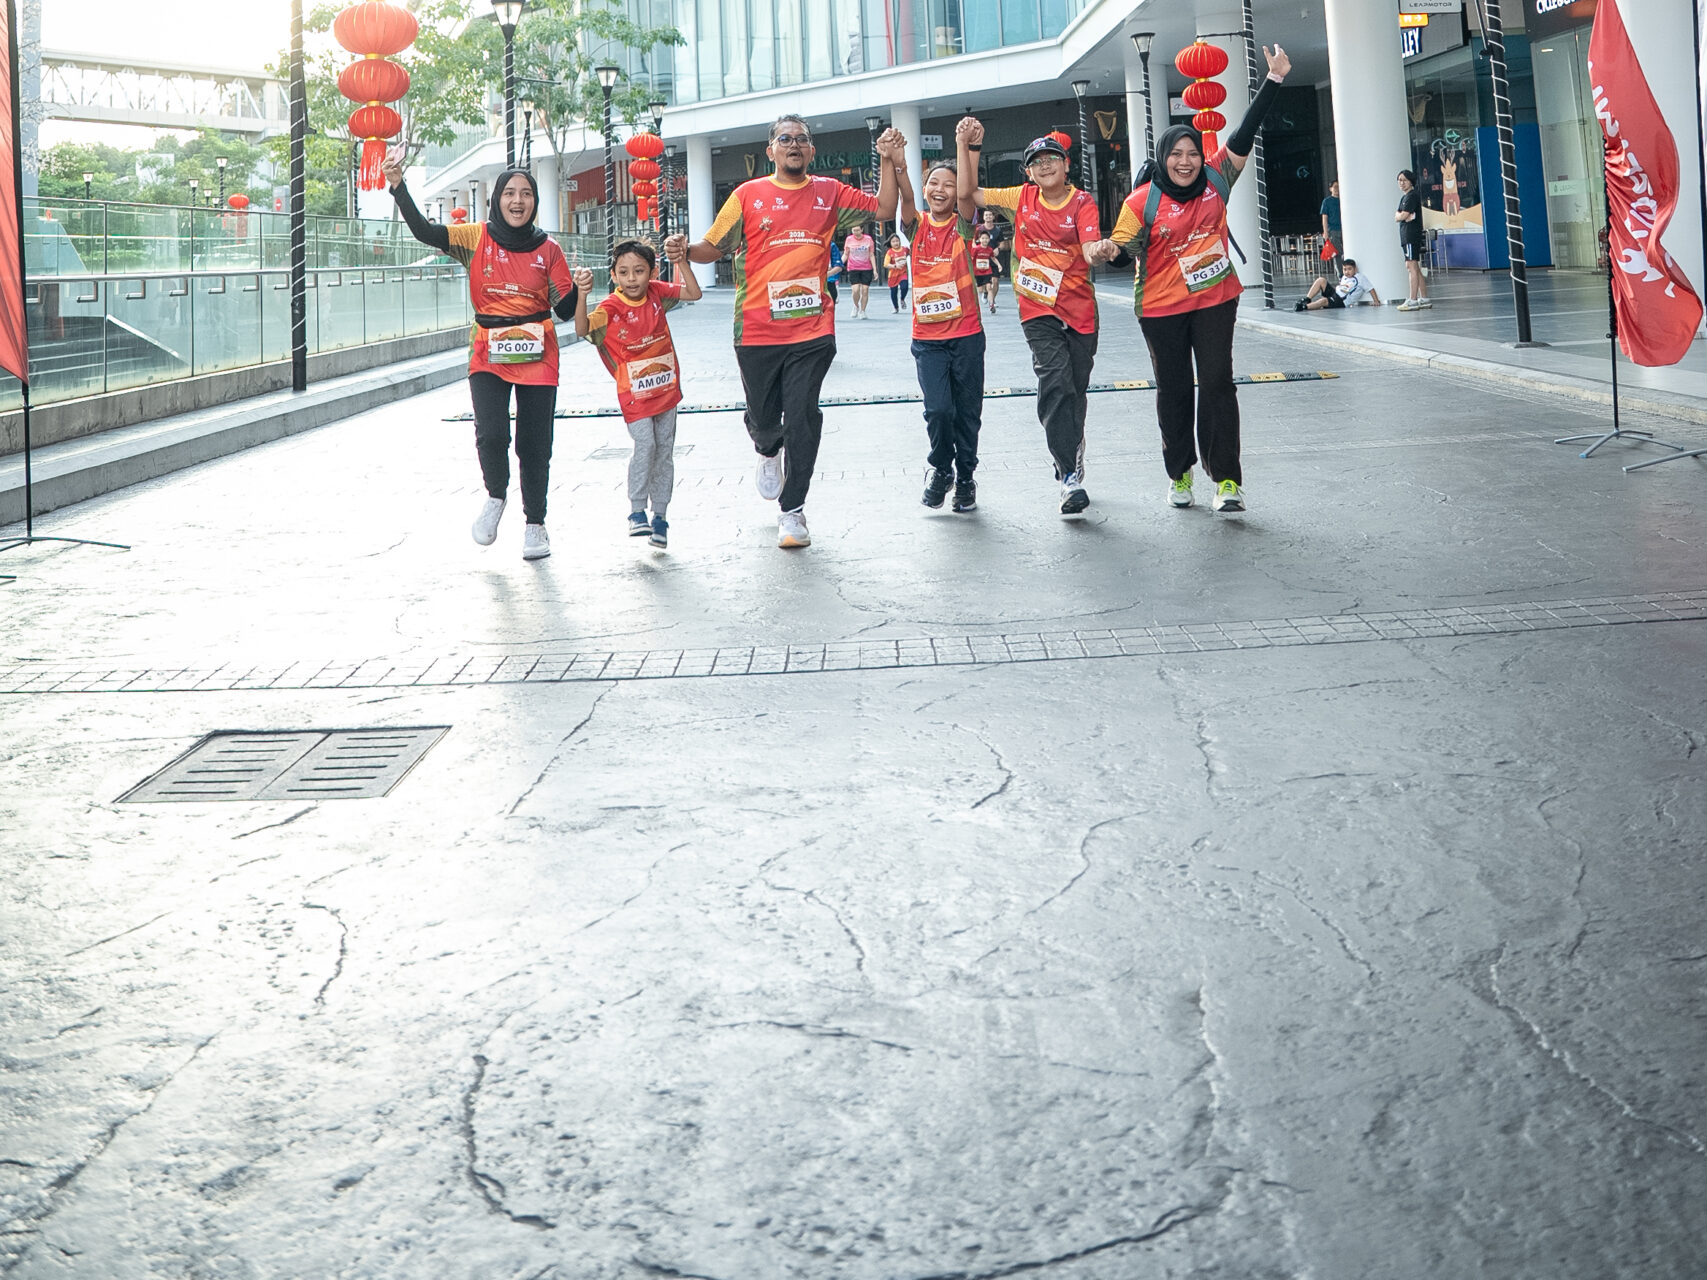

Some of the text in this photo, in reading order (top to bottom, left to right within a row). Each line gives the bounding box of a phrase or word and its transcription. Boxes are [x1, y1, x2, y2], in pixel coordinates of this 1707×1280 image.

[1192, 261, 1224, 282] PG 331
[1021, 277, 1048, 295] BF 331
[778, 297, 813, 309] PG 330
[921, 301, 952, 314] BF 330
[497, 343, 535, 352] PG 007
[638, 378, 654, 390] AM
[655, 373, 671, 385] 007
